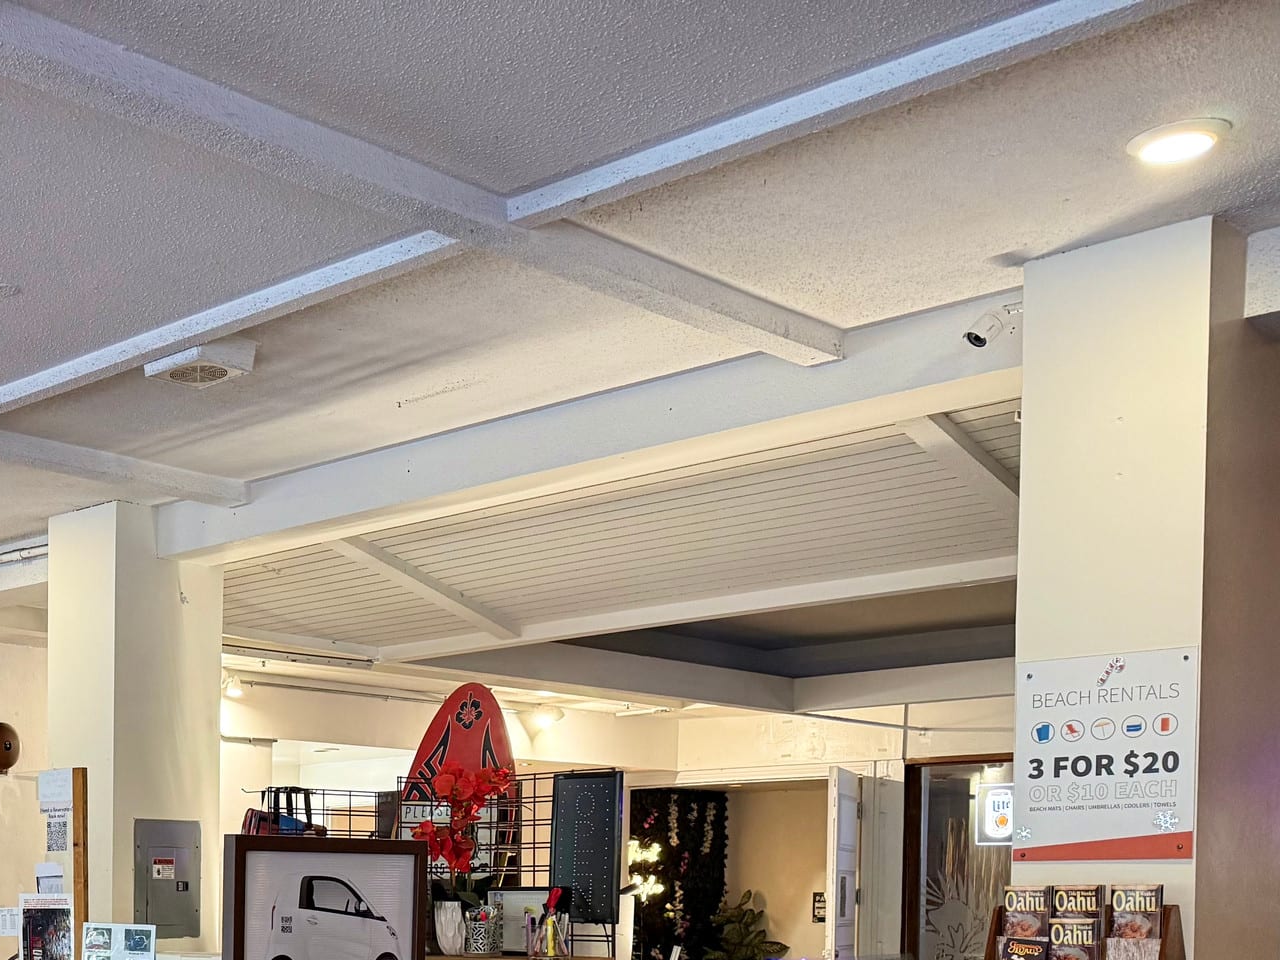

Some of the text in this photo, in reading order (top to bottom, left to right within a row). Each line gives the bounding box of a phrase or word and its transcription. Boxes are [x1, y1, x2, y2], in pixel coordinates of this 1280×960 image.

[1032, 683, 1181, 709] BEACH RENTALS
[1028, 750, 1180, 780] 3 FOR $20
[1029, 780, 1177, 803] OR $10 EACH
[572, 791, 596, 912] OPEN
[1005, 891, 1045, 912] Oahu
[1055, 891, 1097, 912] Oahu
[1113, 890, 1157, 912] Oahu
[1051, 924, 1093, 945] Oahu
